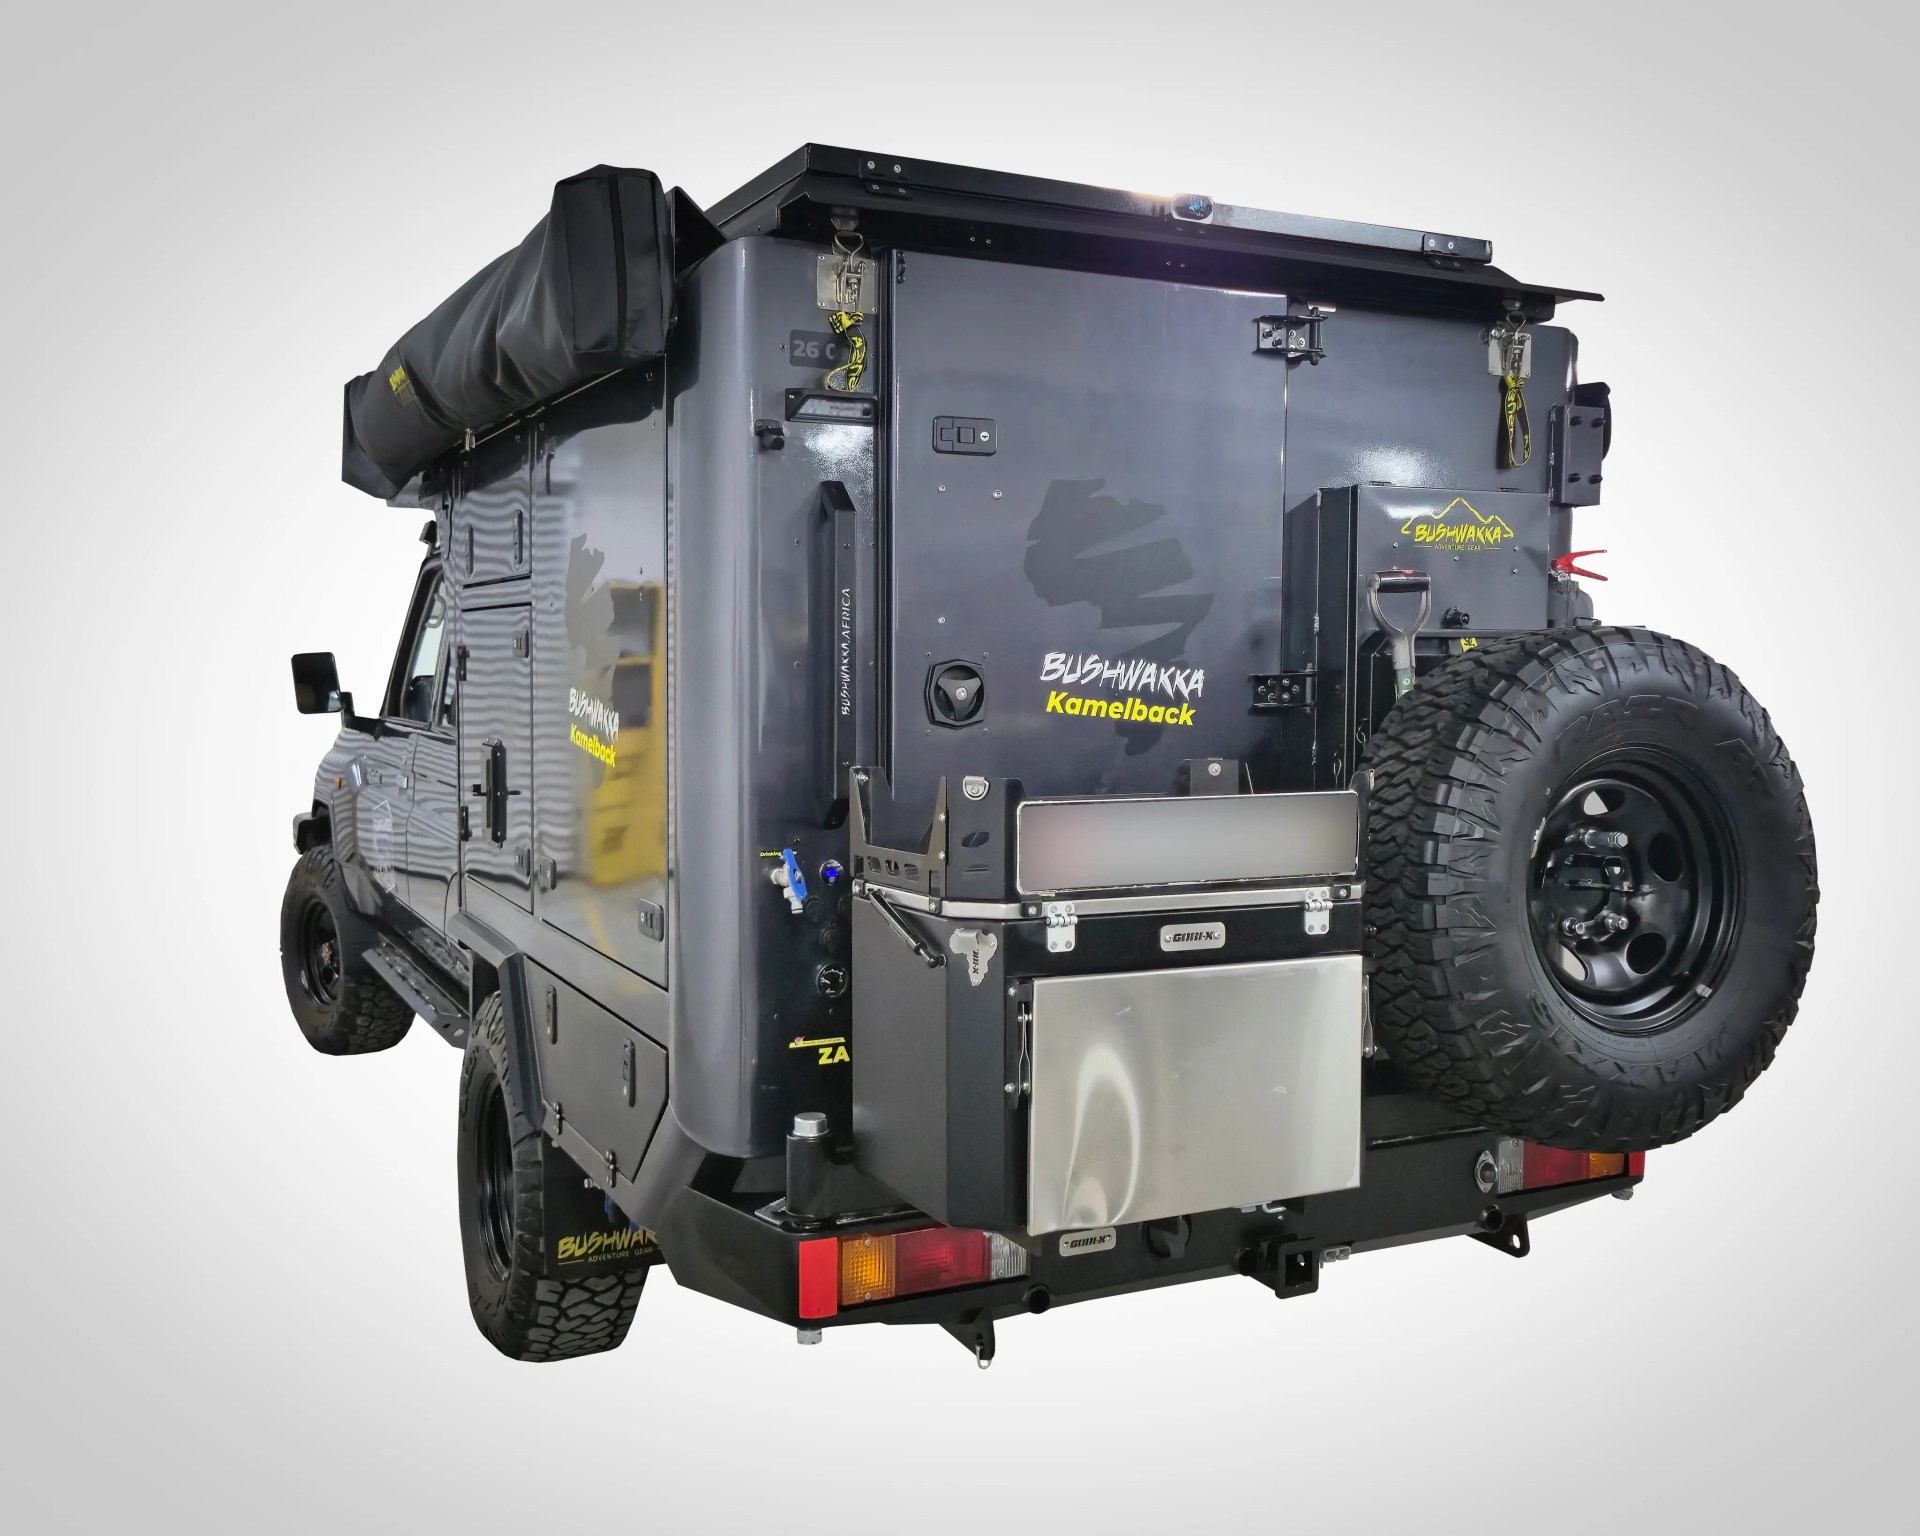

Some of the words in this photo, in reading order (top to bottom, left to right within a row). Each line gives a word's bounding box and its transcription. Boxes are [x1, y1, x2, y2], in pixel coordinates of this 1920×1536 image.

[793, 340, 819, 358] 26
[1414, 523, 1502, 546] BUSHWAKKA
[1040, 651, 1205, 701] BUSHWAKKA
[569, 686, 620, 743] BUSHWAKKA
[1046, 690, 1197, 726] Kamelback
[570, 722, 617, 768] Kamelback
[818, 1045, 851, 1065] ZA
[557, 1226, 659, 1260] BUSHWAK
[588, 1251, 630, 1263] ADVENTURE
[634, 1246, 653, 1256] GEAR
